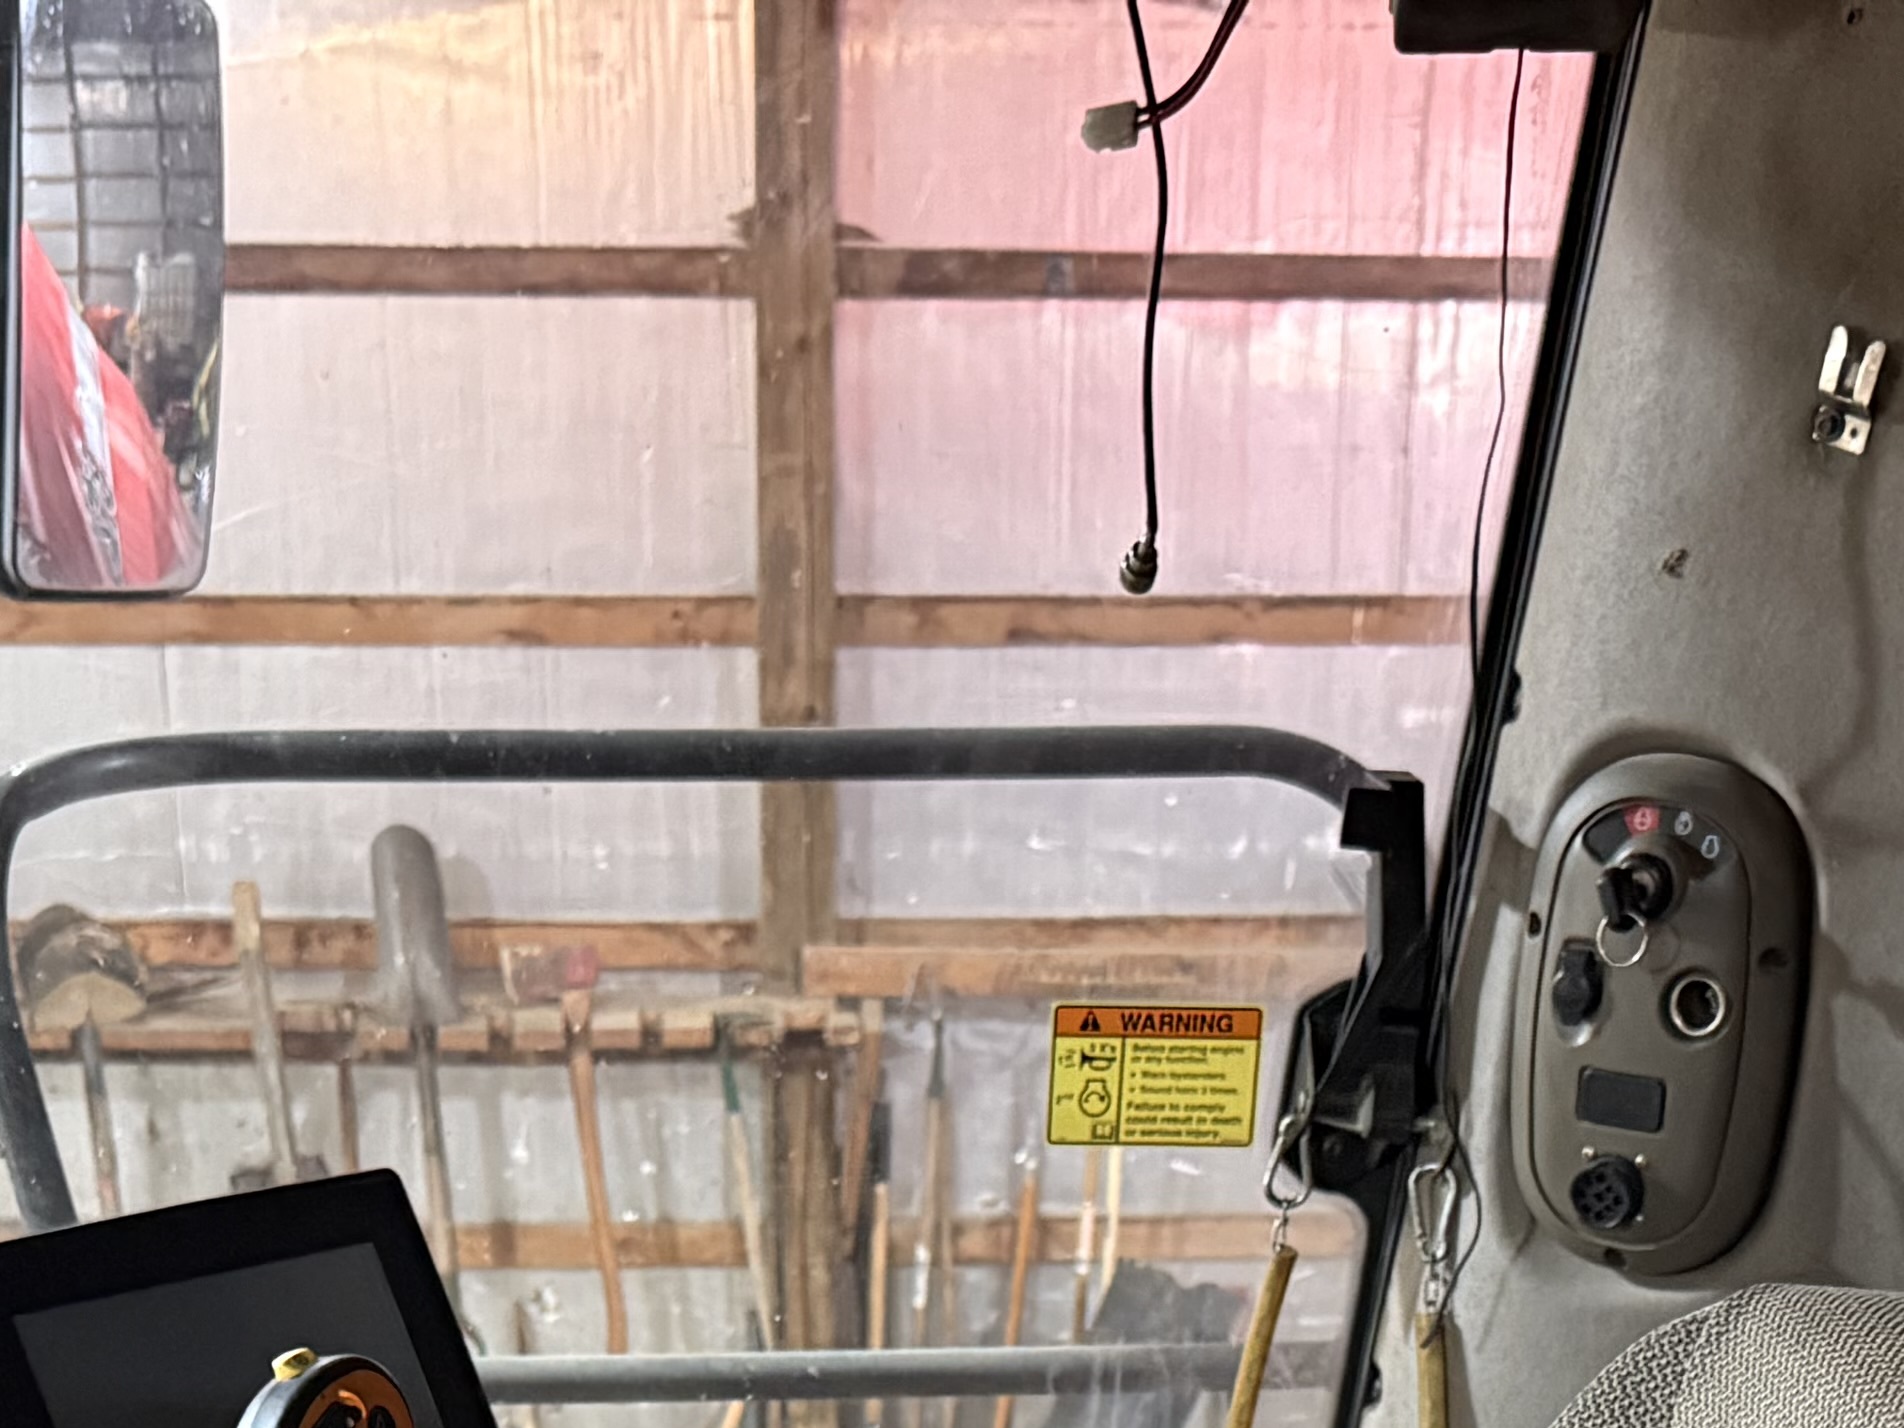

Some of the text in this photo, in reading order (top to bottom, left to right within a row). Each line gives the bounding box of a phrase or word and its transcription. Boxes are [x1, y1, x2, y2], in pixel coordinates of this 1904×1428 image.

[1121, 1012, 1234, 1033] WARNING
[1168, 1045, 1207, 1057] starting
[1210, 1046, 1244, 1056] engine
[1126, 1101, 1226, 1114] Failure to comply
[1125, 1116, 1242, 1125] could result in death
[1124, 1129, 1137, 1137] or
[1140, 1129, 1183, 1138] serious
